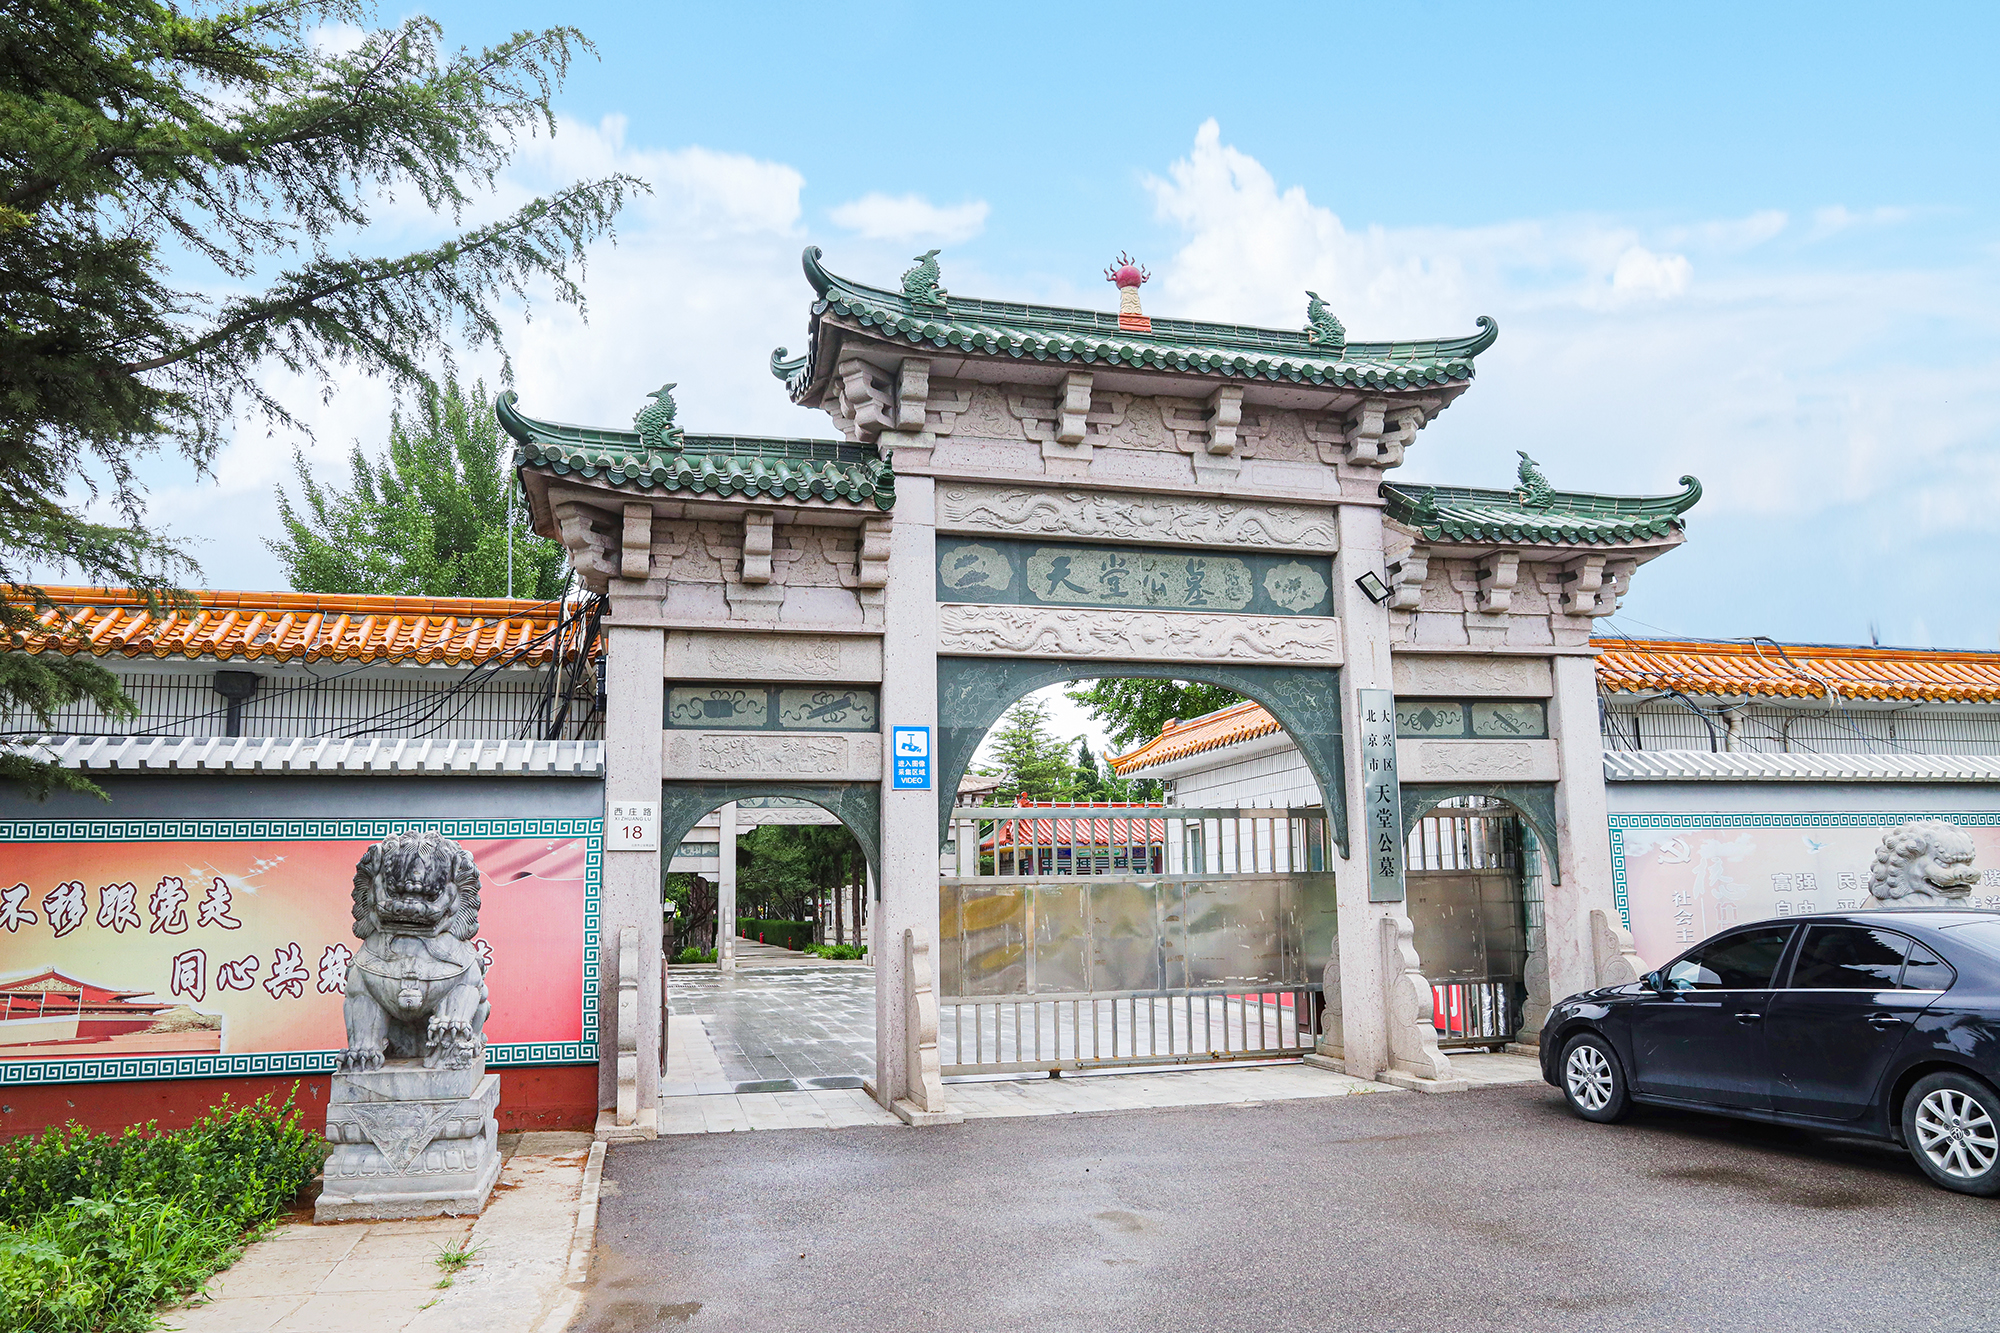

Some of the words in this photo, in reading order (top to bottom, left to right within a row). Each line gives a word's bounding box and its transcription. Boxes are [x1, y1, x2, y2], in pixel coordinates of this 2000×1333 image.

[1046, 553, 1215, 606] 天堂公墓
[1366, 709, 1379, 772] 北京市
[1381, 709, 1393, 772] 大兴区
[614, 807, 651, 816] 西庄路
[622, 825, 643, 839] 18
[1375, 783, 1395, 878] 天堂公墓
[0, 876, 242, 938] 不移跟党走
[1771, 872, 1817, 892] 富强
[1775, 900, 1817, 917] 自由
